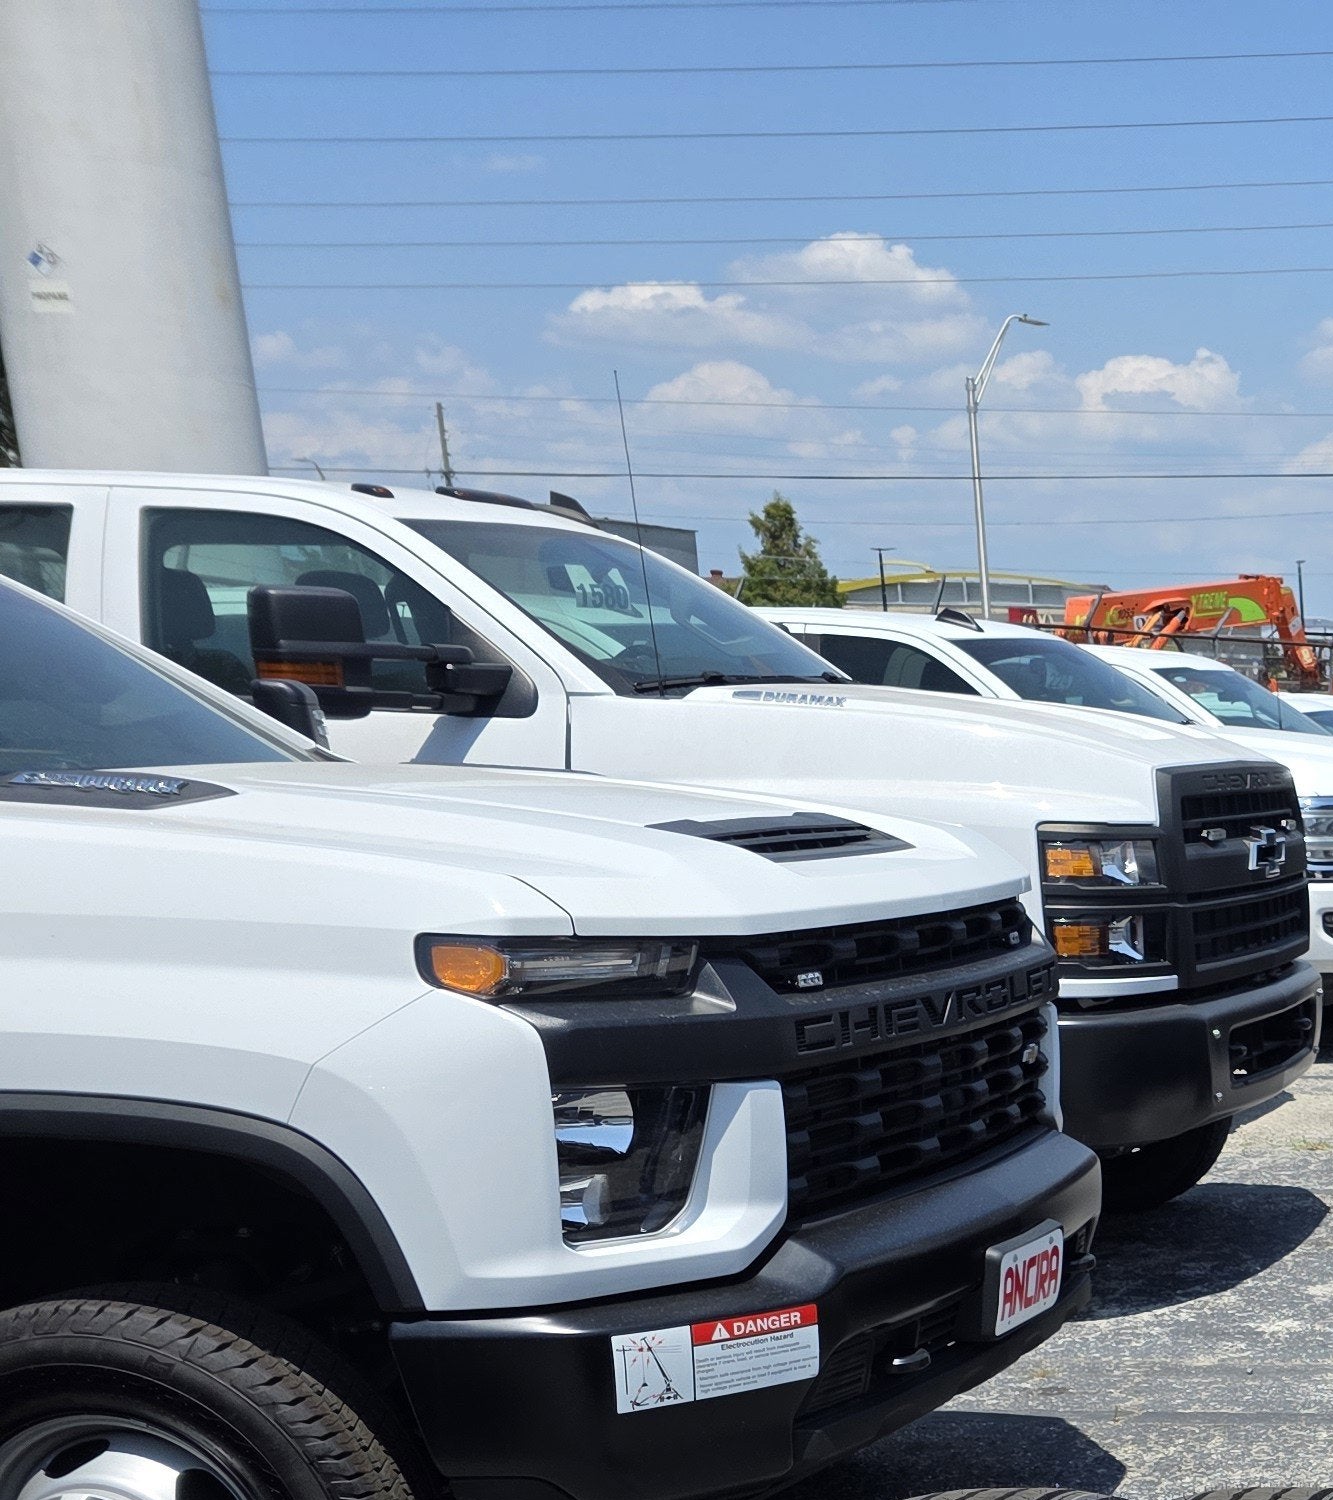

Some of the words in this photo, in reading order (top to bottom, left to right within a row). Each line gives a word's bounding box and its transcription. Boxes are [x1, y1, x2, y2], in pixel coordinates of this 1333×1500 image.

[763, 691, 847, 707] DURAMAX
[1000, 1244, 1060, 1322] ANCIRA
[733, 1311, 802, 1337] DANGER
[720, 1336, 769, 1351] Electrocution
[770, 1332, 795, 1343] Hazard
